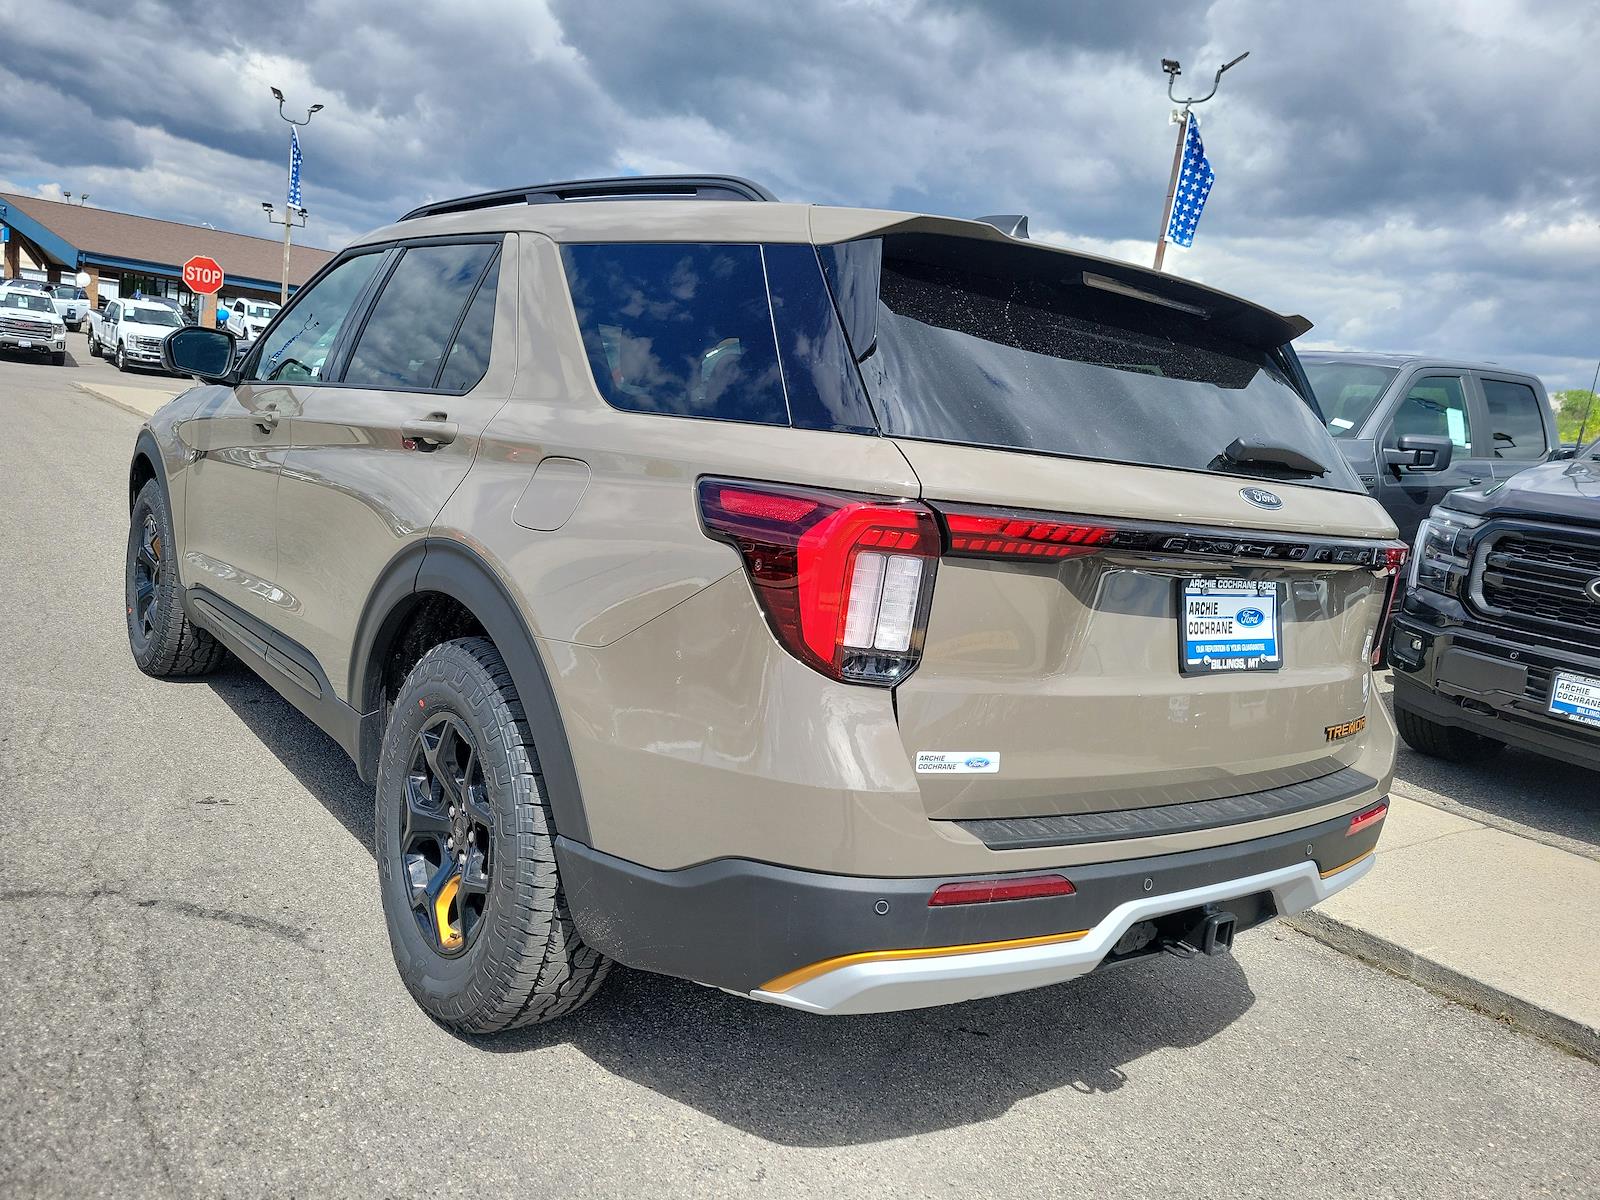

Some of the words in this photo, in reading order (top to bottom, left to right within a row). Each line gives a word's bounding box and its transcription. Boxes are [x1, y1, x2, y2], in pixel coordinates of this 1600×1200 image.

[186, 266, 221, 284] STOP
[1252, 489, 1278, 504] Ford
[1189, 579, 1217, 589] ARCHIE
[1217, 580, 1256, 590] COCHRANE
[1257, 581, 1277, 590] FORD
[1188, 602, 1219, 615] ARCHIE
[1240, 610, 1260, 624] Ford
[1188, 621, 1233, 635] COCHRANE
[1210, 658, 1247, 670] BILLINGS,
[1247, 657, 1260, 668] MT
[1559, 683, 1591, 695] ARCHIE
[1324, 716, 1367, 742] TREMOR
